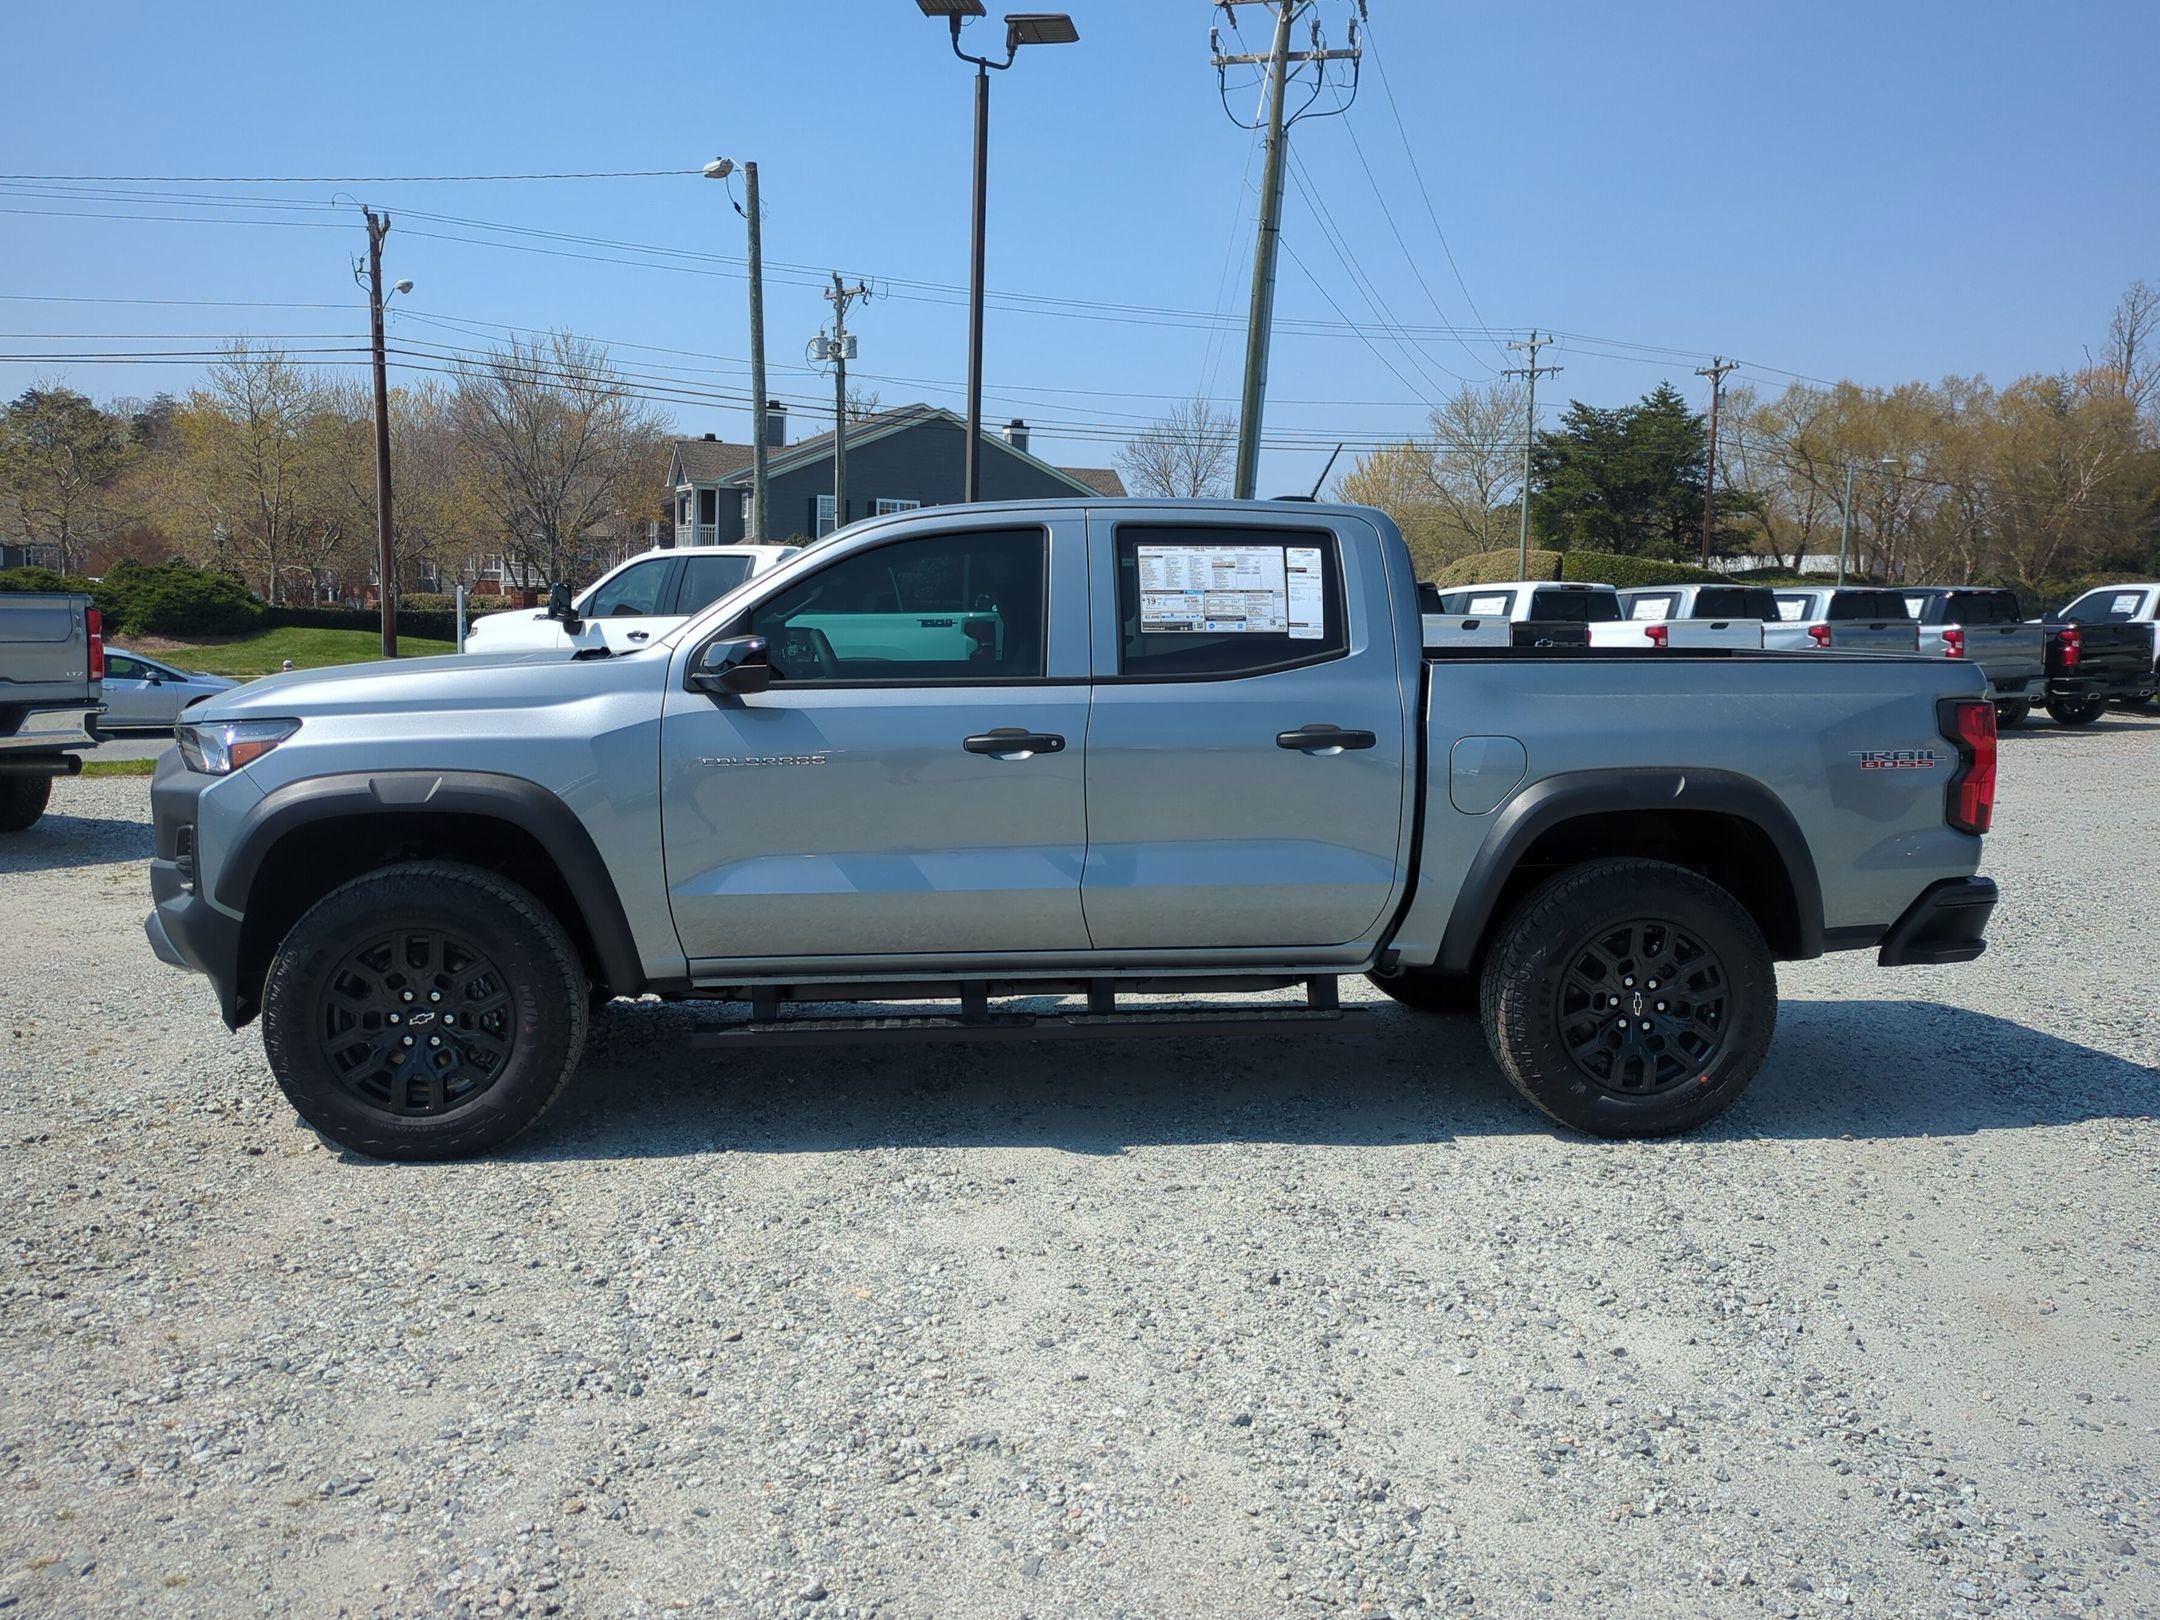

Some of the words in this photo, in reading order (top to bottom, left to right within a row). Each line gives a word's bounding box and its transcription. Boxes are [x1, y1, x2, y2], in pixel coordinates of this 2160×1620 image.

[701, 755, 826, 767] COLORADO
[1848, 749, 1947, 761] TRAIL
[1860, 760, 1935, 769] BOSS
